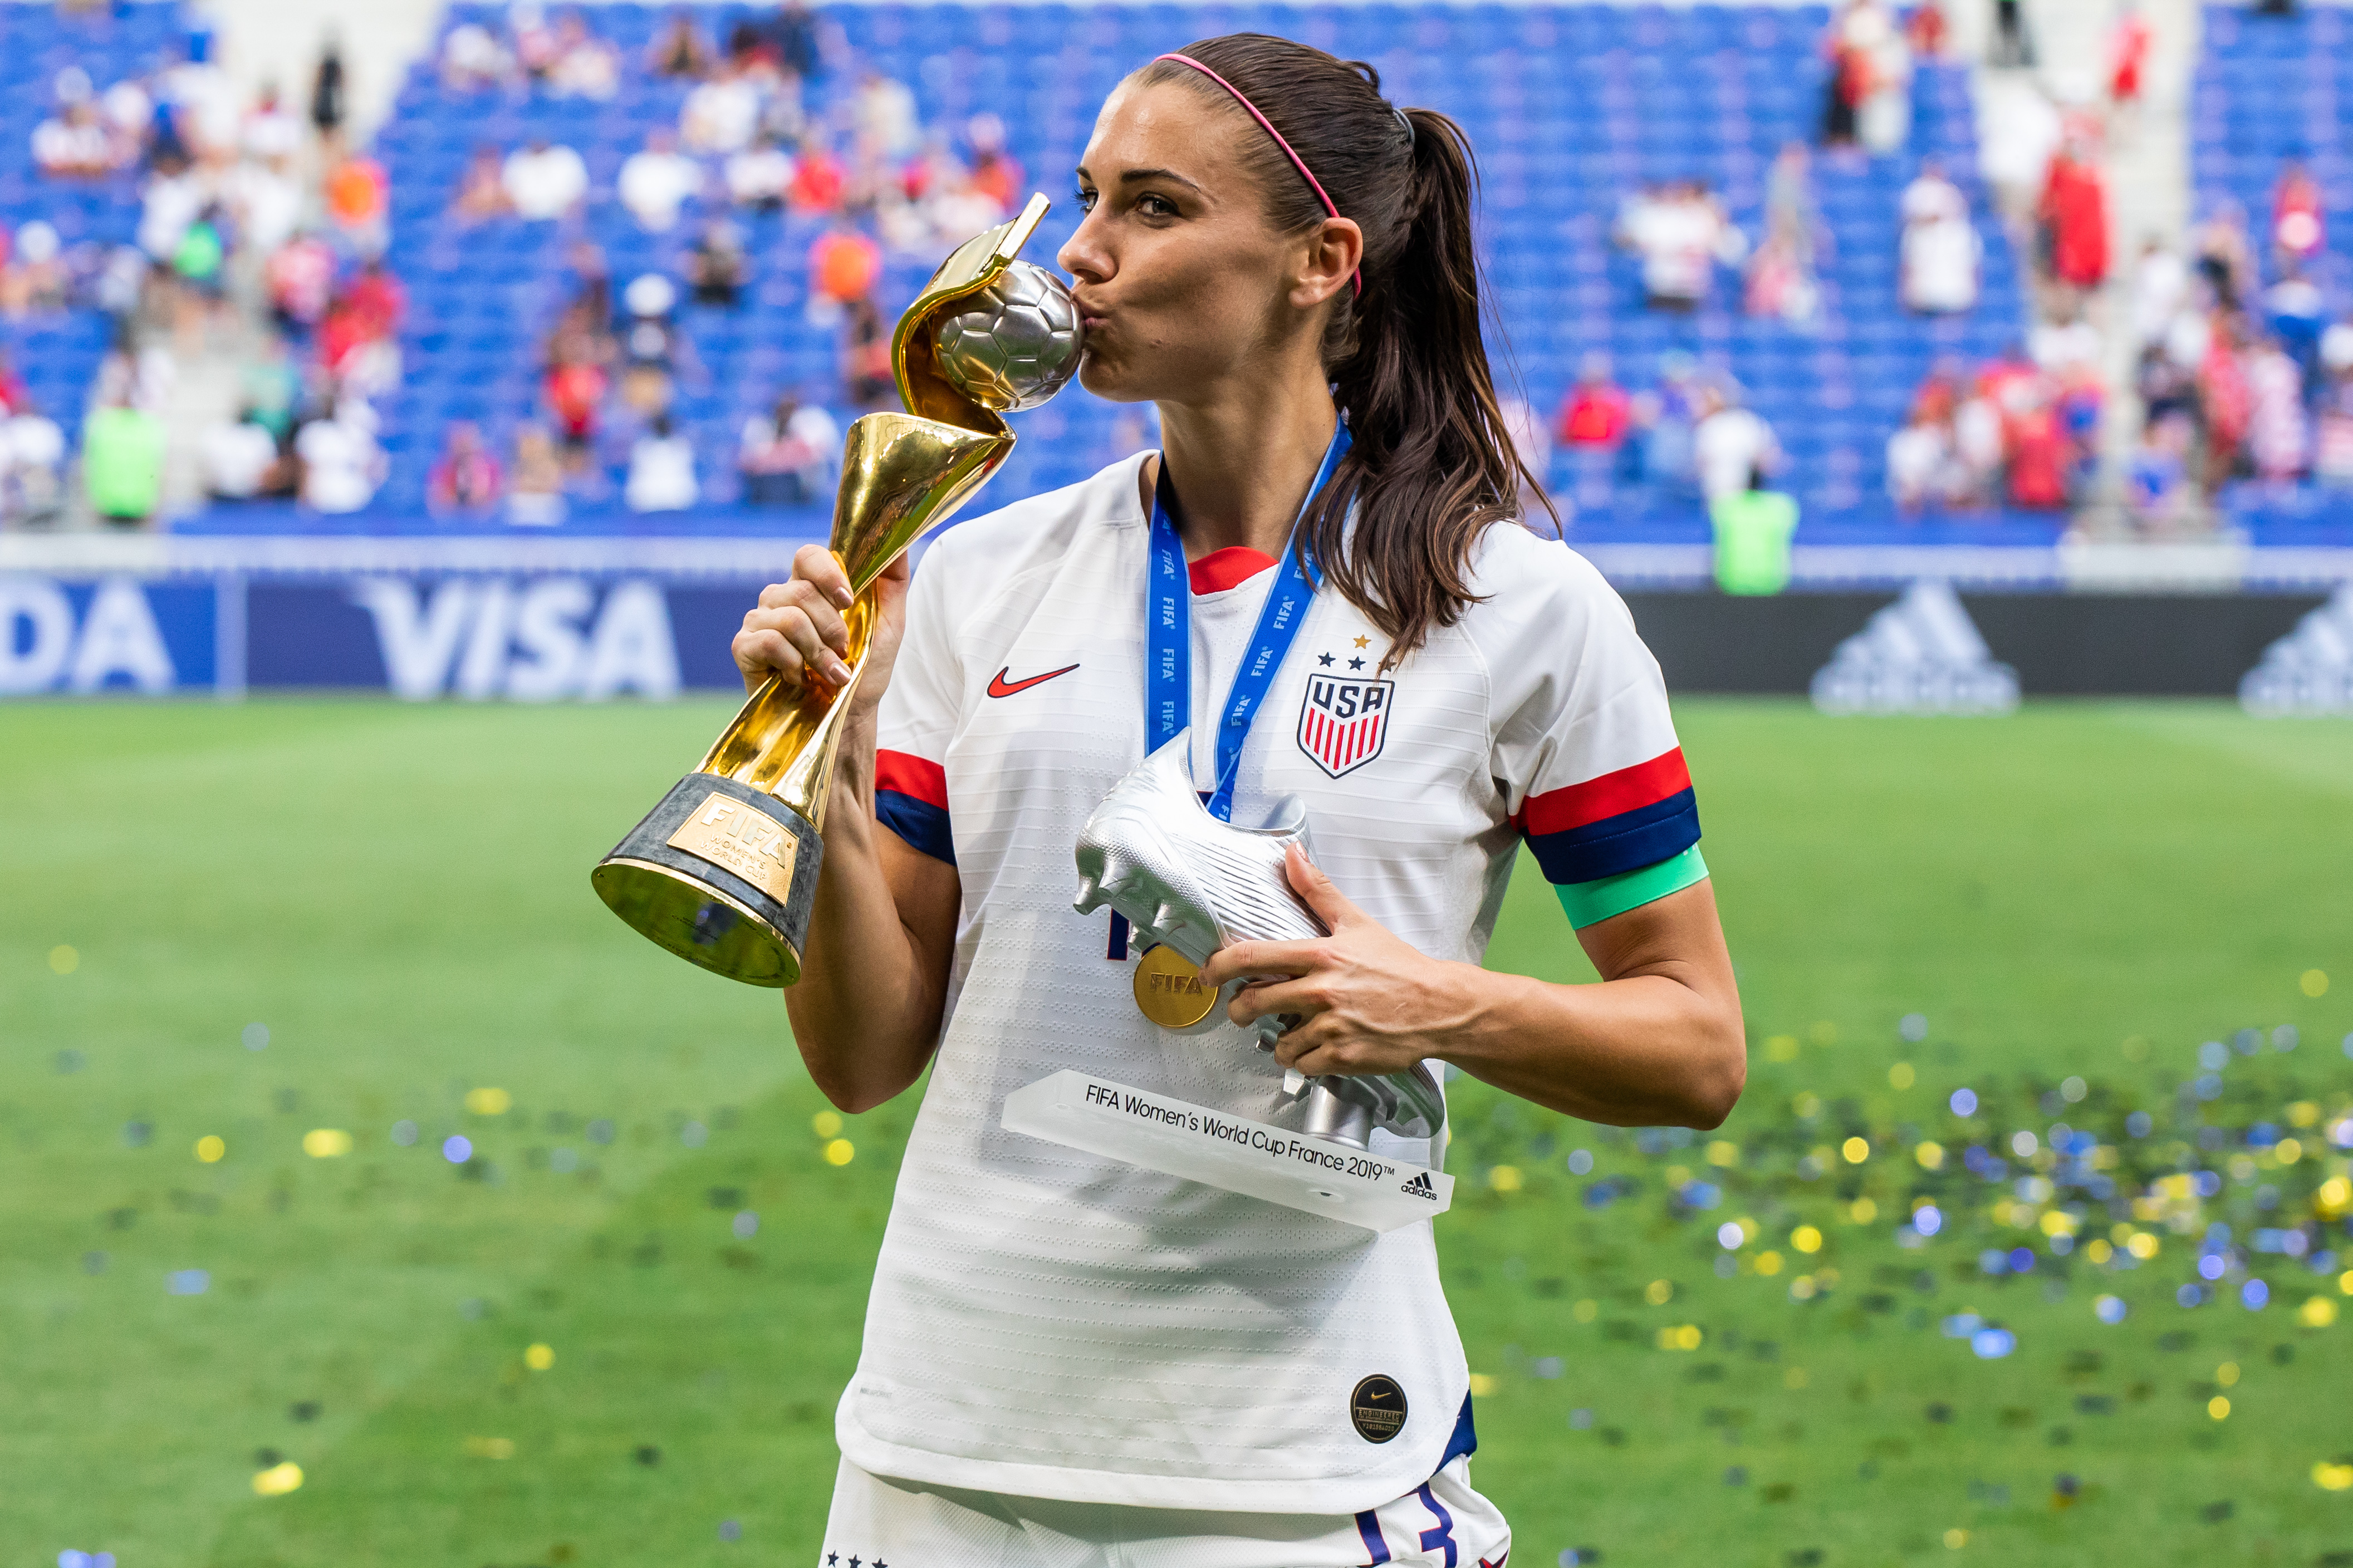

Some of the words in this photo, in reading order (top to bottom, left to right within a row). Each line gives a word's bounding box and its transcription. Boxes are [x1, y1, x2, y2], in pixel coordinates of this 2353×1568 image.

[354, 577, 683, 697] VISA
[1312, 681, 1385, 719] USA
[700, 840, 742, 867] WORLD
[745, 865, 768, 881] CUP
[710, 833, 767, 870] WOMEN'S
[1149, 972, 1203, 996] FIFA
[1086, 1084, 1119, 1110] FIFA
[1125, 1094, 1199, 1131] Women's
[1204, 1115, 1249, 1145] World
[1252, 1130, 1286, 1158] Cup
[1288, 1139, 1345, 1171] France
[1400, 1184, 1438, 1201] adidas
[1359, 1409, 1400, 1419] ENGINEERED
